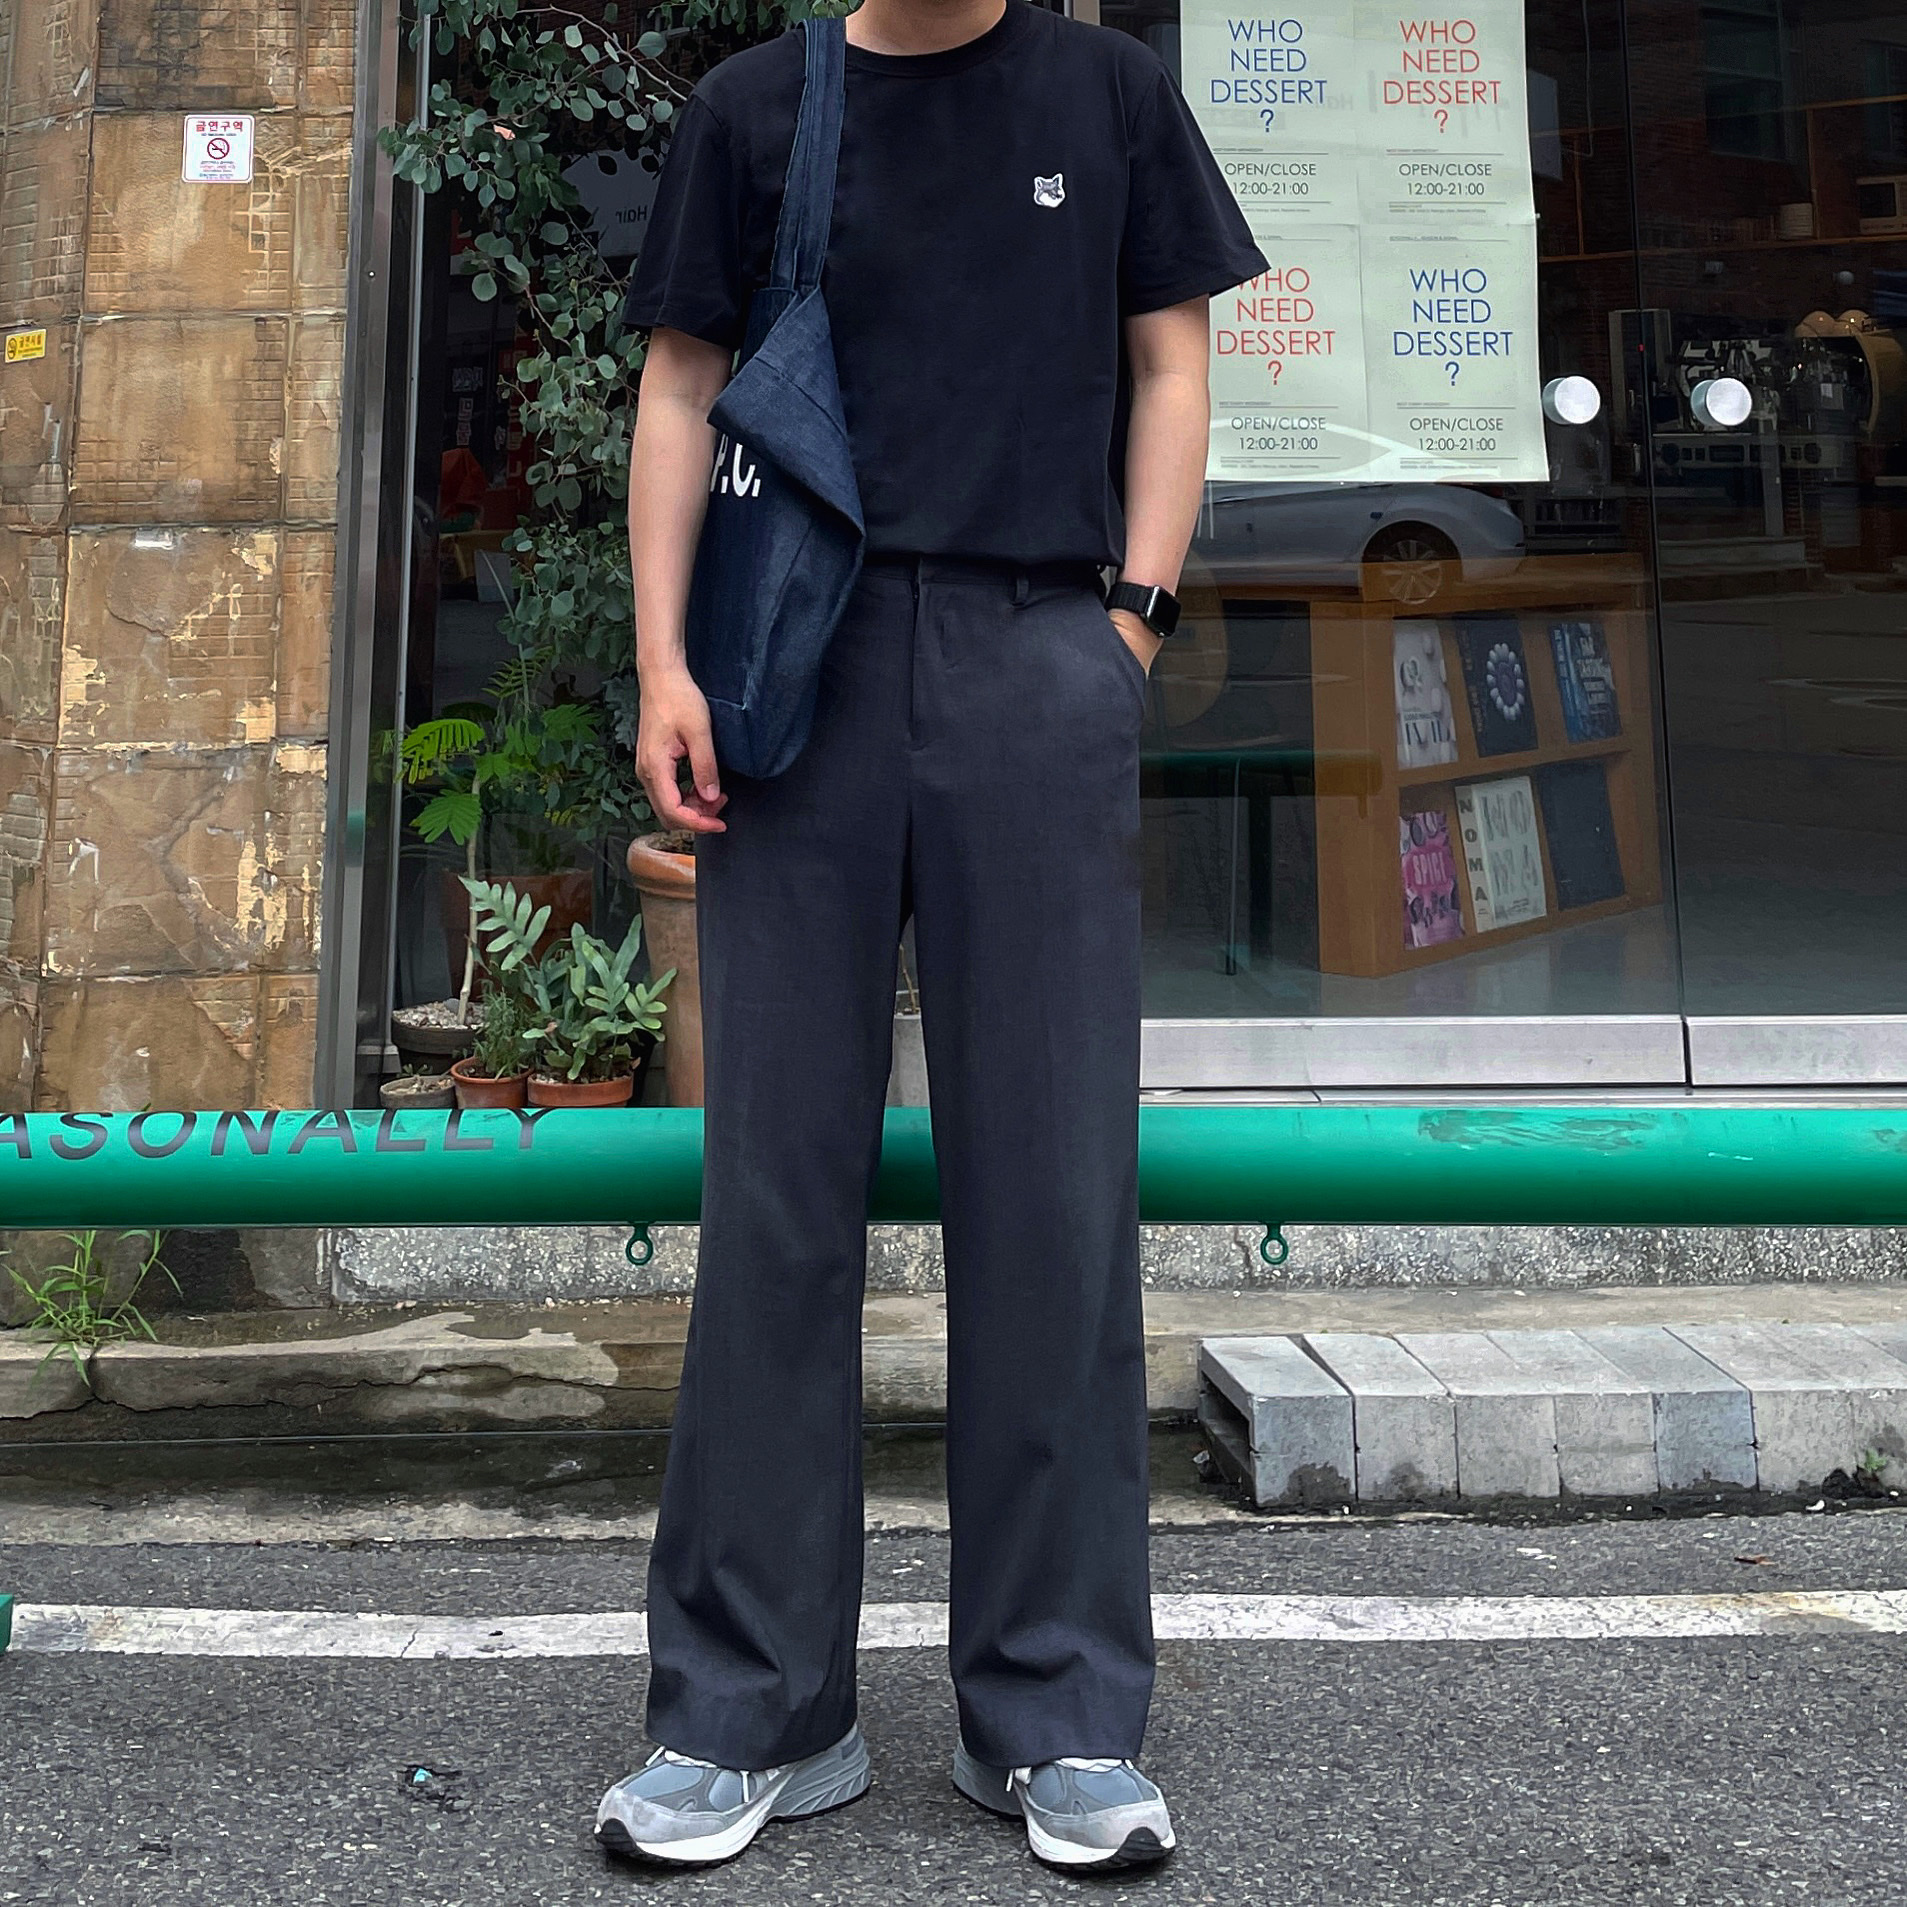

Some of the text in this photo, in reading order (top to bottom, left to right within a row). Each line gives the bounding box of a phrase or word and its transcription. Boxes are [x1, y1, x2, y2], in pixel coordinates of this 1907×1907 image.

[1227, 19, 1303, 44] WHO
[1399, 19, 1476, 45] WHO
[1230, 48, 1307, 73] NEED
[1402, 49, 1480, 73] NEED
[1210, 79, 1328, 105] DESSERT
[1383, 79, 1501, 105] DESSERT
[195, 120, 243, 133] 금연구역
[1259, 109, 1275, 134] ?
[1434, 109, 1449, 134] ?
[1224, 163, 1317, 177] OPEN/CLOSE
[1398, 163, 1492, 178] OPEN/CLOSE
[1232, 182, 1309, 196] 12:00-21:00
[1407, 183, 1485, 196] 12:00-21:00
[1409, 268, 1487, 294] WHO
[1236, 298, 1314, 323] NEED
[1412, 298, 1492, 324] NEED
[1216, 330, 1336, 356] DESSERT
[1393, 330, 1514, 357] DESSERT
[1267, 360, 1282, 386] ?
[1444, 361, 1460, 387] ?
[1231, 416, 1326, 431] OPEN/CLOSE
[1409, 417, 1504, 432] OPEN/CLOSE
[1239, 437, 1318, 451] 12:00-21:00
[1418, 437, 1497, 452] 12:00-21:00
